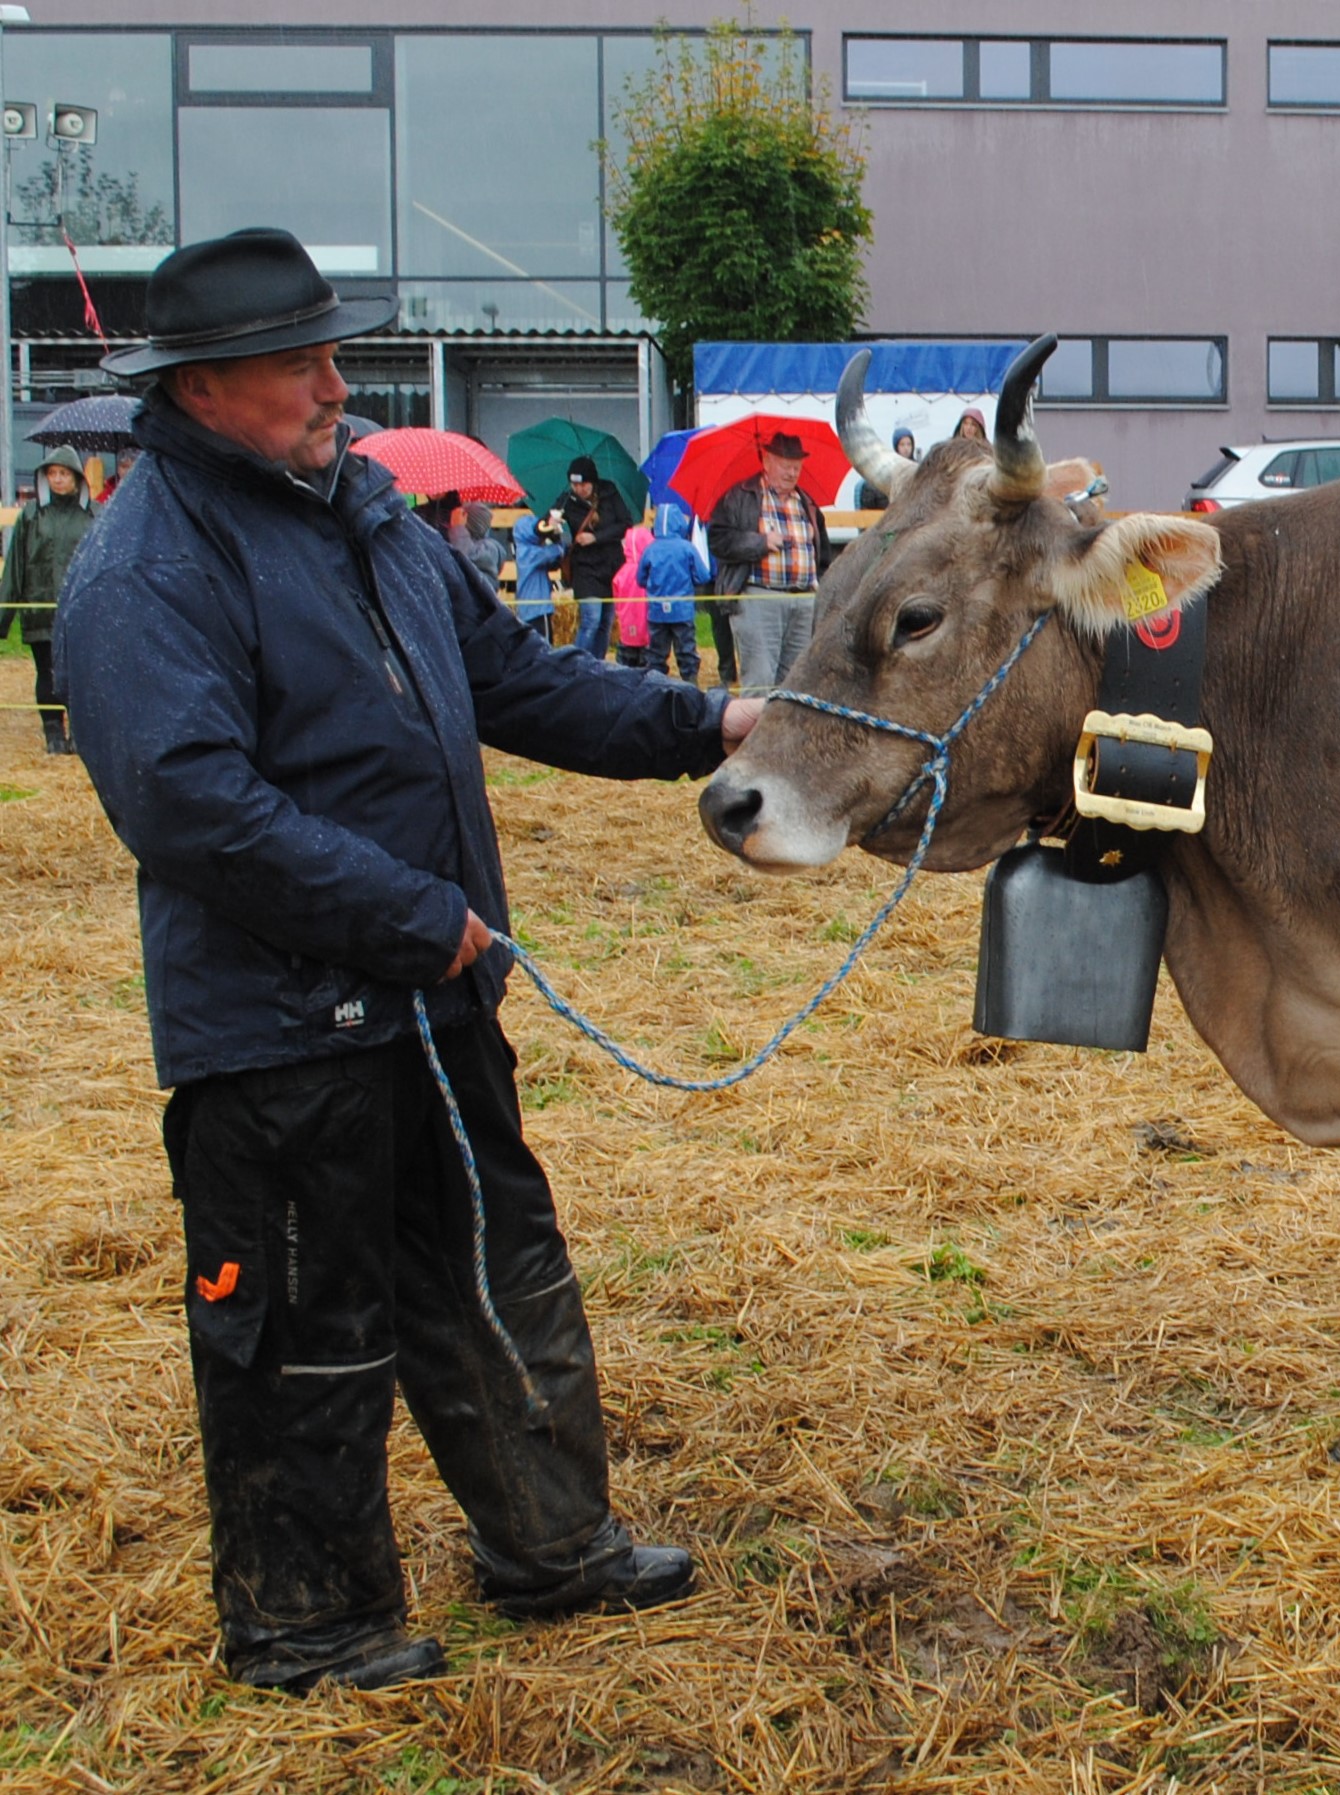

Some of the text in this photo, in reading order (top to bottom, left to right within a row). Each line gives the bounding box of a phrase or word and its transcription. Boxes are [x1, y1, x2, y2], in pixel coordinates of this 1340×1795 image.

[335, 1000, 365, 1022] HH
[287, 1200, 299, 1305] HELLY HANSEN
